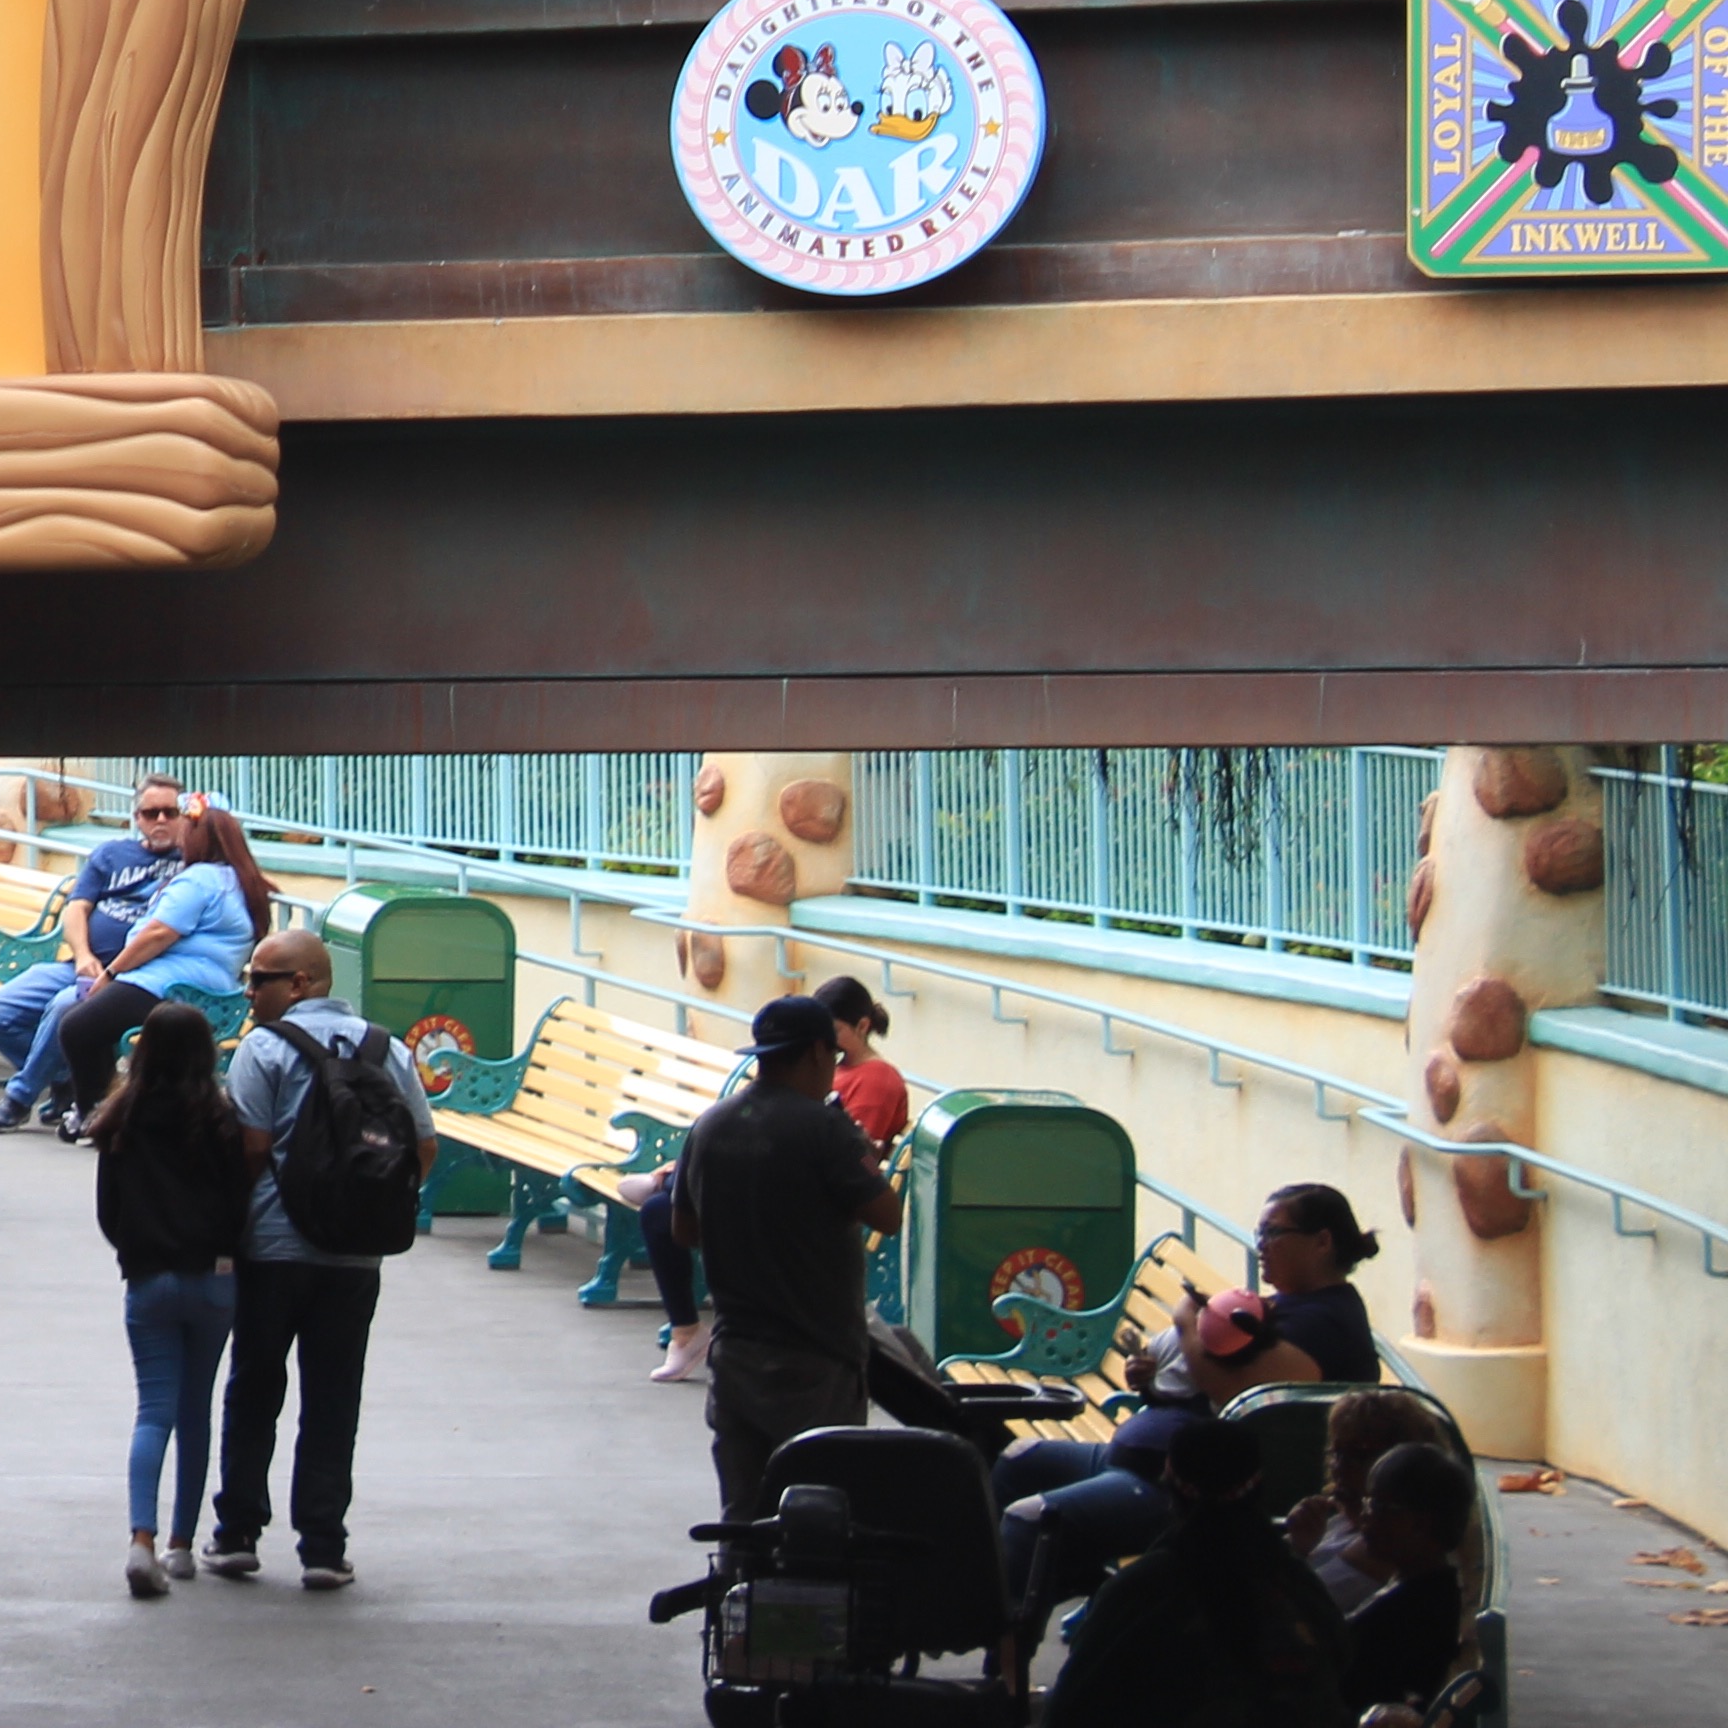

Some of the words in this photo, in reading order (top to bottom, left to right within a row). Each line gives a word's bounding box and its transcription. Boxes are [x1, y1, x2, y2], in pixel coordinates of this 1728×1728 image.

[907, 0, 944, 27] OF
[953, 33, 995, 93] THE
[1433, 33, 1462, 176] LOYAL
[722, 171, 905, 259] ANIMATED
[920, 163, 991, 239] REEL
[751, 132, 960, 231] DAR
[1510, 222, 1665, 253] INKWELL
